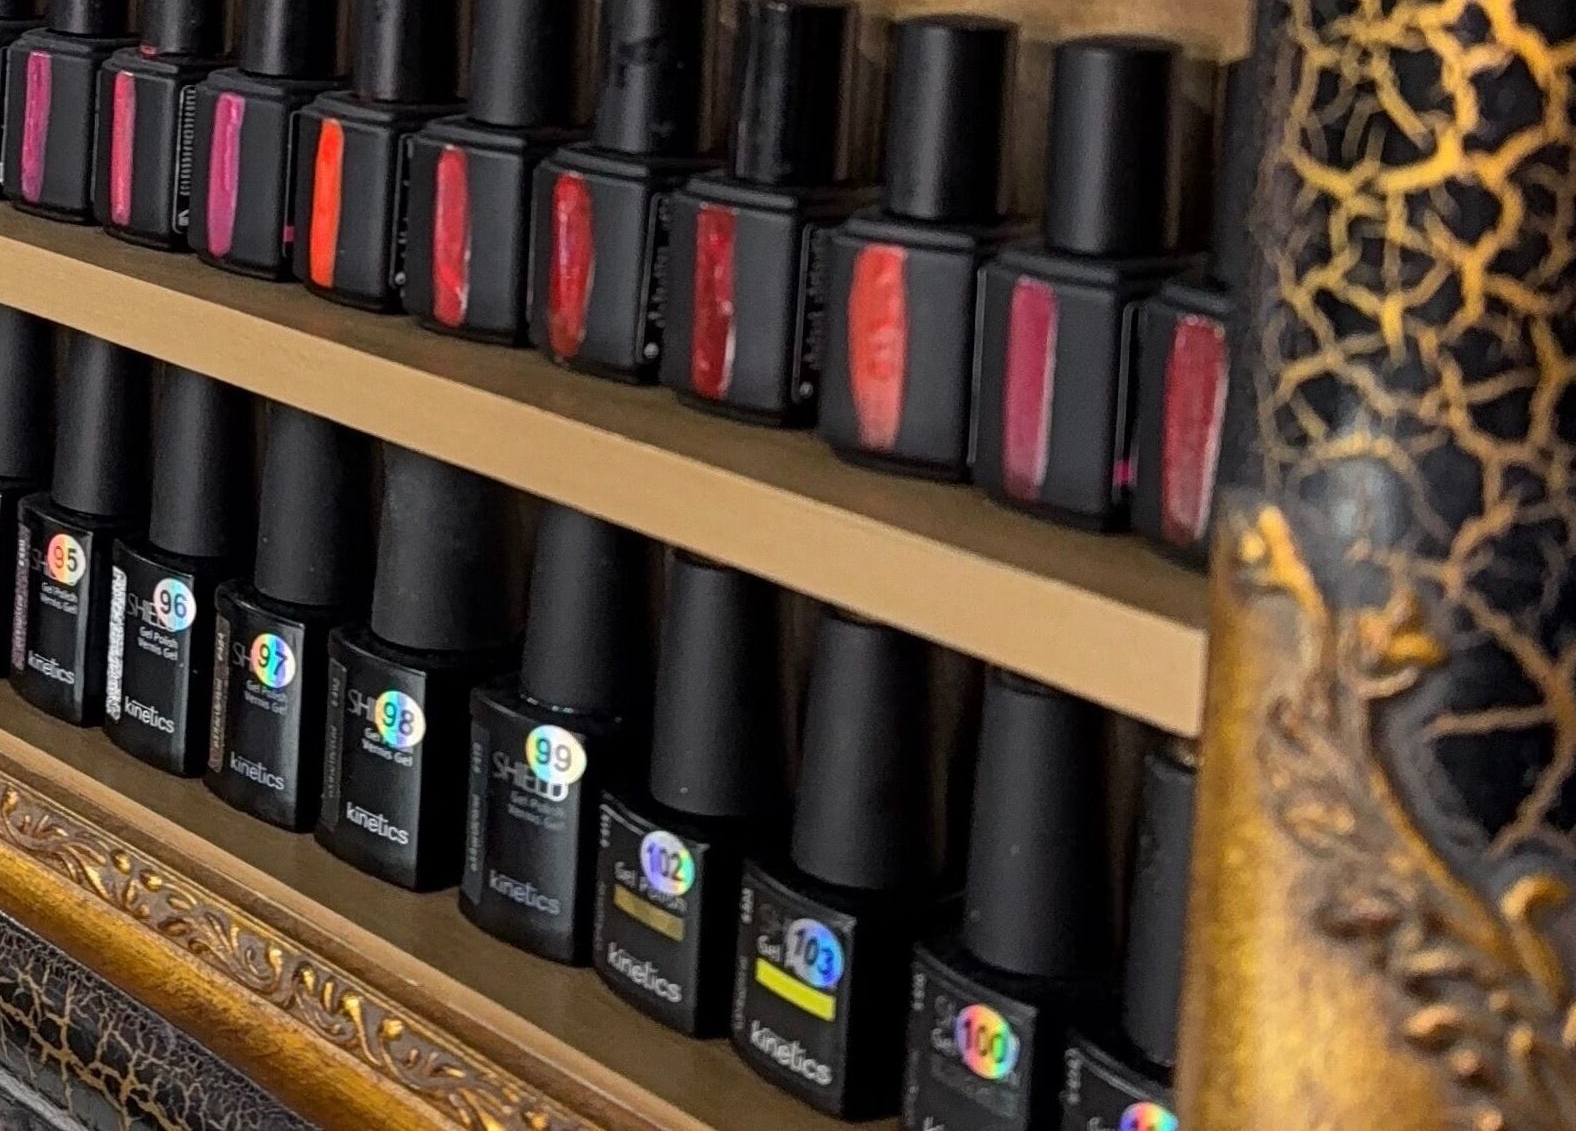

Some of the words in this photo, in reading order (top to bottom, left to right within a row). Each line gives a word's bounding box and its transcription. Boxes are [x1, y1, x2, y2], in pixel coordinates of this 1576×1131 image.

[53, 546, 78, 571] 95
[160, 590, 187, 618] 96
[27, 650, 74, 684] kinetics
[258, 643, 287, 676] 97
[124, 697, 174, 734] kinetics
[382, 702, 415, 736] 98
[230, 751, 285, 790] kinetics
[536, 737, 572, 773] 99
[346, 801, 409, 845] kinetics
[646, 842, 685, 883] 102
[489, 870, 561, 916] kinetics
[795, 929, 834, 975] 103
[607, 941, 684, 1004] kinetics
[750, 1019, 833, 1086] kinetics
[965, 1019, 1007, 1064] 100
